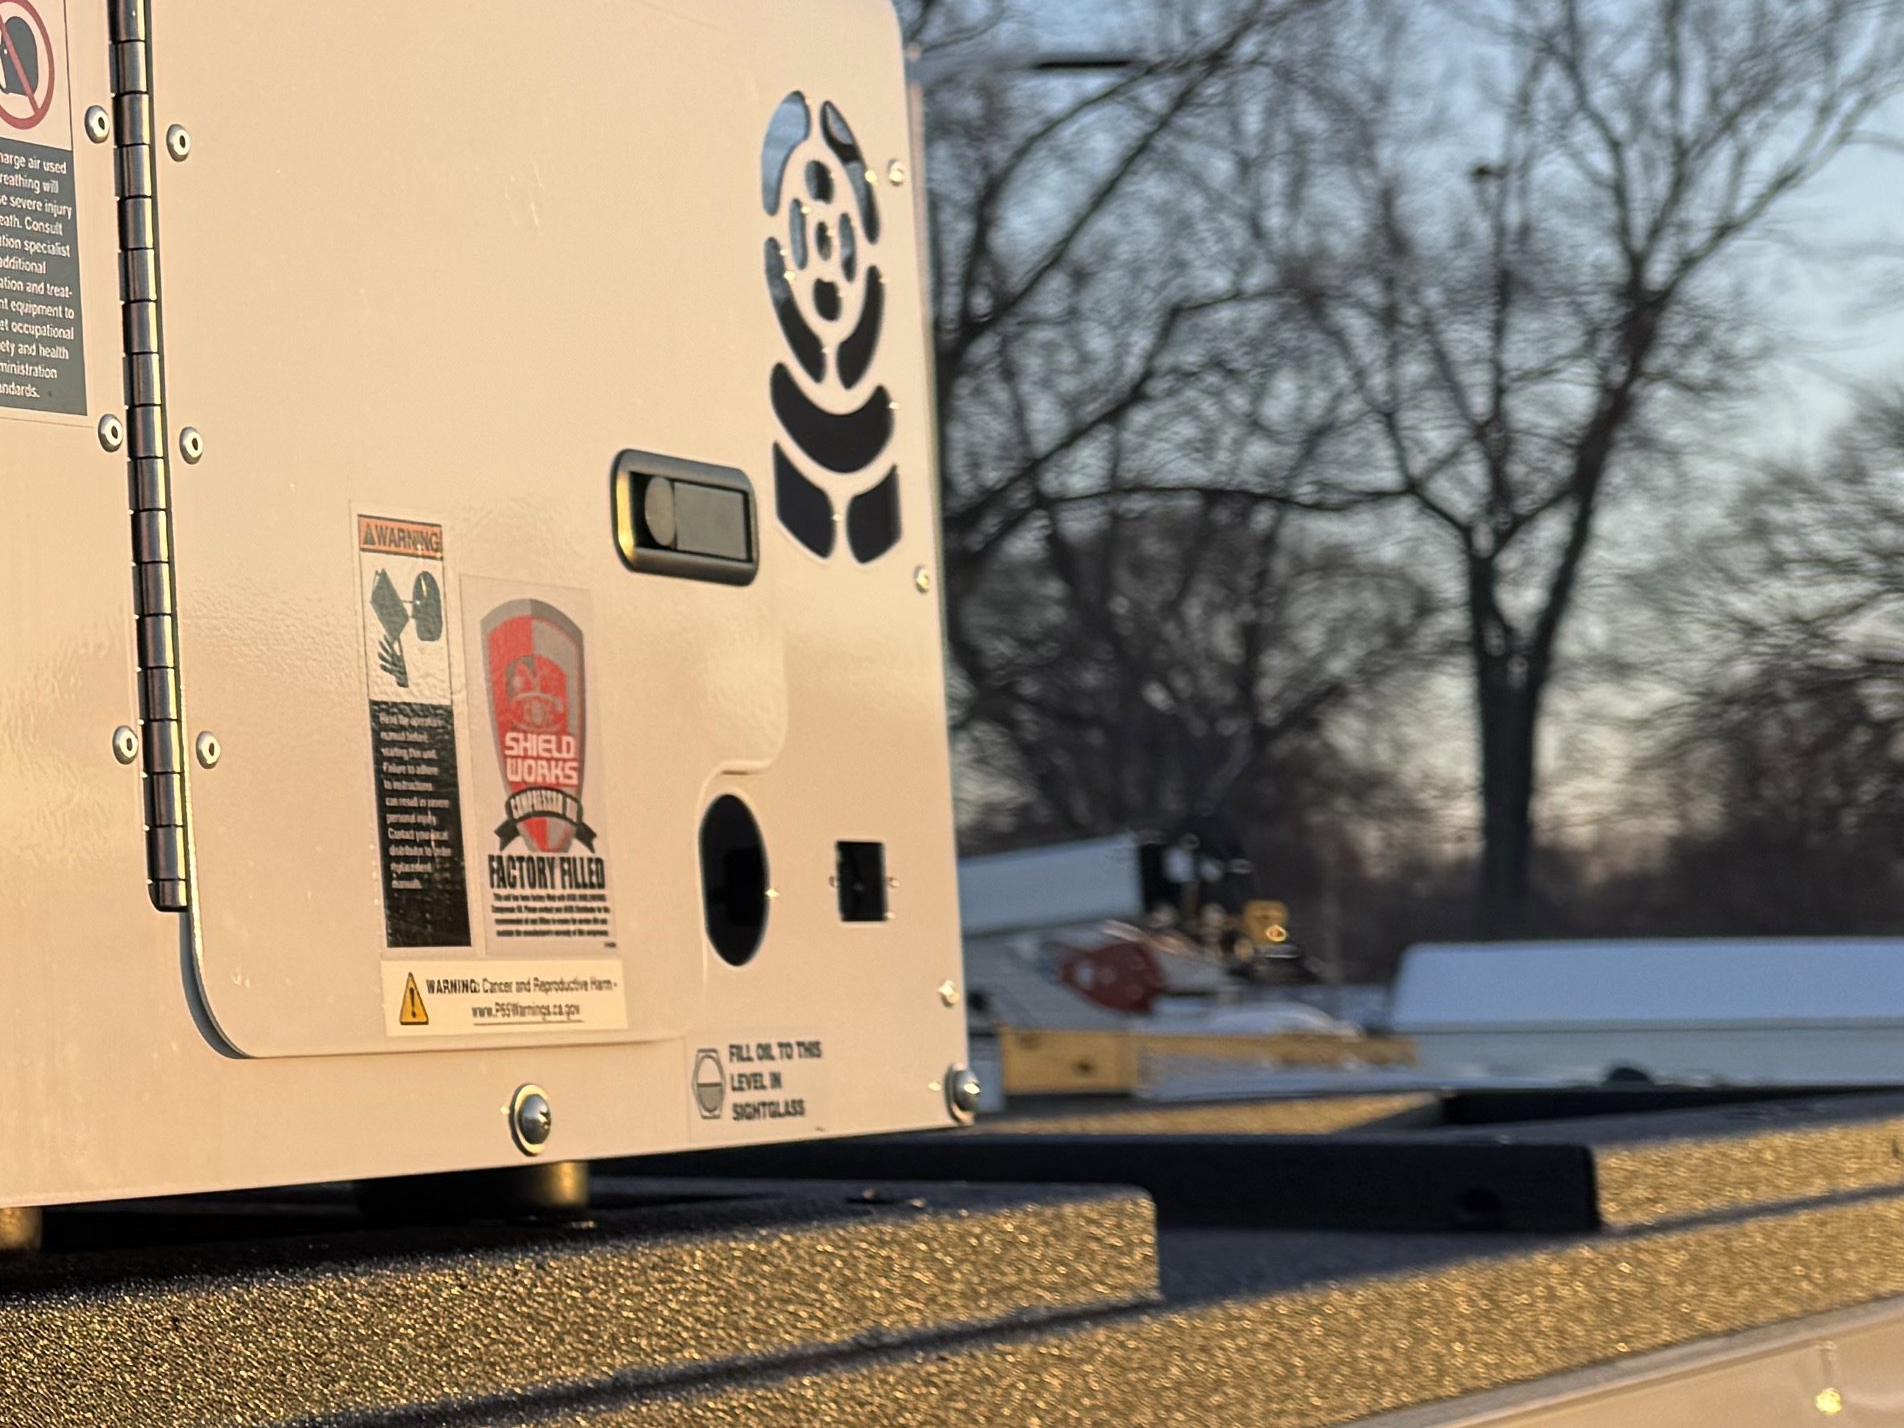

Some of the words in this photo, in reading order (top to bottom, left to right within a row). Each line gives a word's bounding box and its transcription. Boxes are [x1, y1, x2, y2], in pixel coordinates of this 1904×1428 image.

[28, 156, 41, 169] air
[43, 161, 66, 174] used
[42, 180, 58, 193] will
[10, 196, 42, 211] severe
[45, 199, 72, 220] injury
[25, 217, 62, 236] Consult
[24, 239, 70, 257] specialist
[26, 282, 44, 295] and
[47, 283, 72, 298] treat-
[11, 300, 62, 318] equipment
[65, 307, 74, 319] to
[11, 322, 74, 340] occupational
[18, 343, 35, 356] and
[39, 343, 68, 359] health
[375, 524, 439, 552] WARNING
[504, 732, 576, 758] SHIELD
[506, 759, 579, 786] WORKS
[488, 854, 555, 889] FACTORY
[559, 856, 605, 890] FILLED
[482, 978, 512, 993] Cancer
[516, 978, 530, 993] and
[533, 977, 588, 996] Reproductive
[729, 1044, 754, 1062] FILL
[756, 1043, 775, 1061] OIL
[777, 1042, 793, 1060] TO
[796, 1041, 822, 1058] THIS
[730, 1072, 767, 1092] LEVEL
[732, 1098, 805, 1121] SIGHTGLASS
